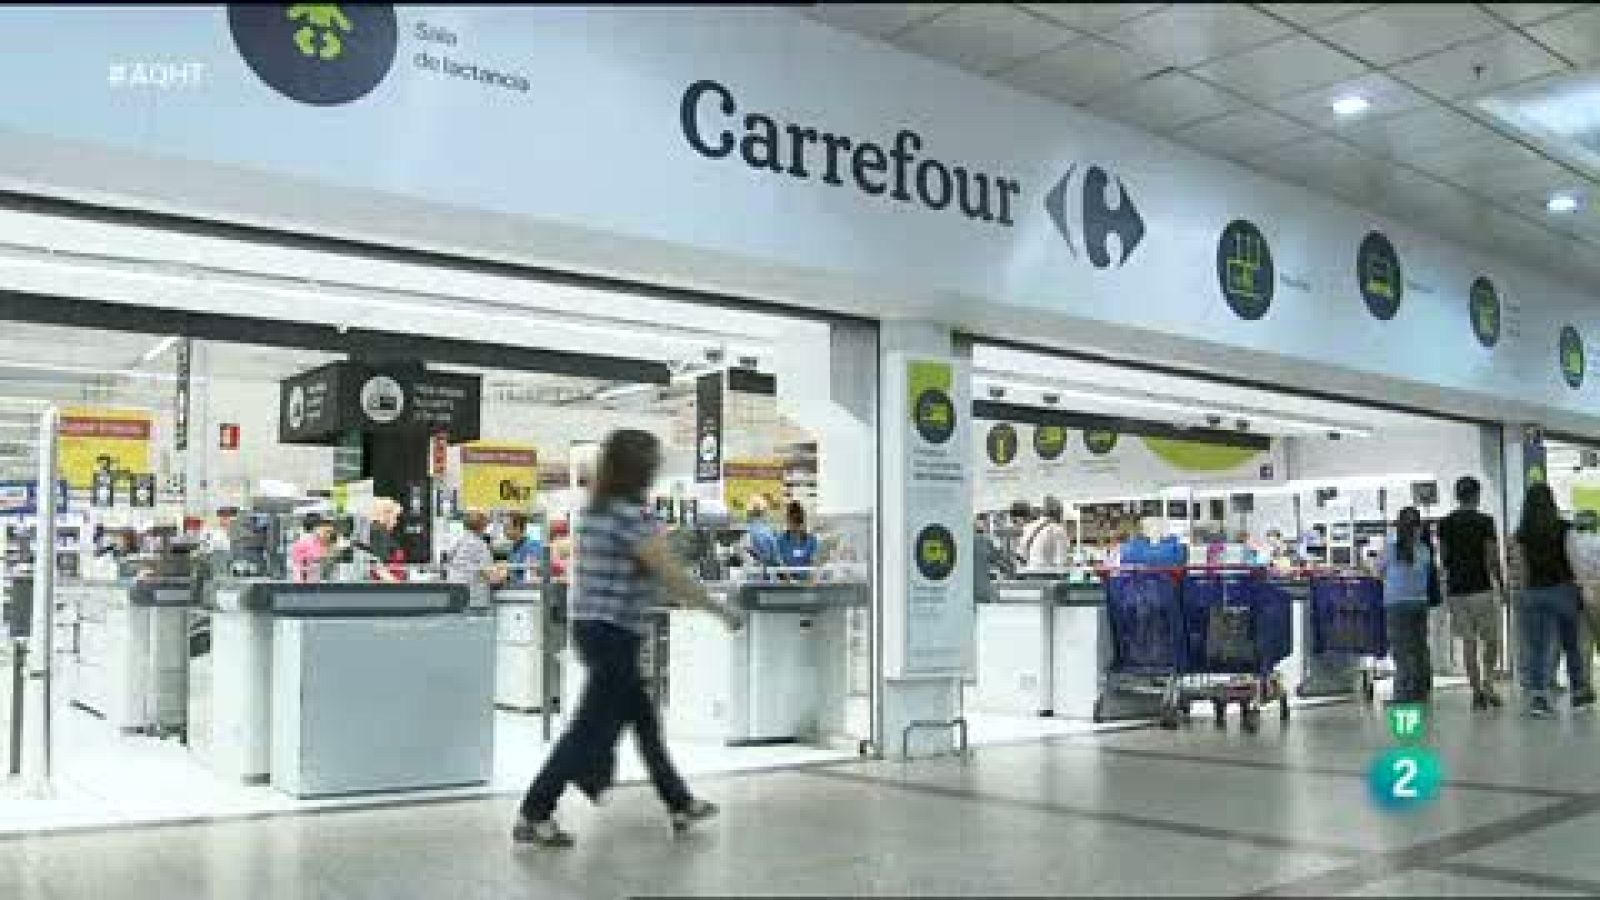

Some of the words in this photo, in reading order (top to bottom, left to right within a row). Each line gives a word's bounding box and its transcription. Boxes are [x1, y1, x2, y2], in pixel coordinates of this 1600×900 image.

[412, 52, 441, 73] de
[442, 56, 530, 93] lactancia
[680, 79, 1021, 226] Carrefour
